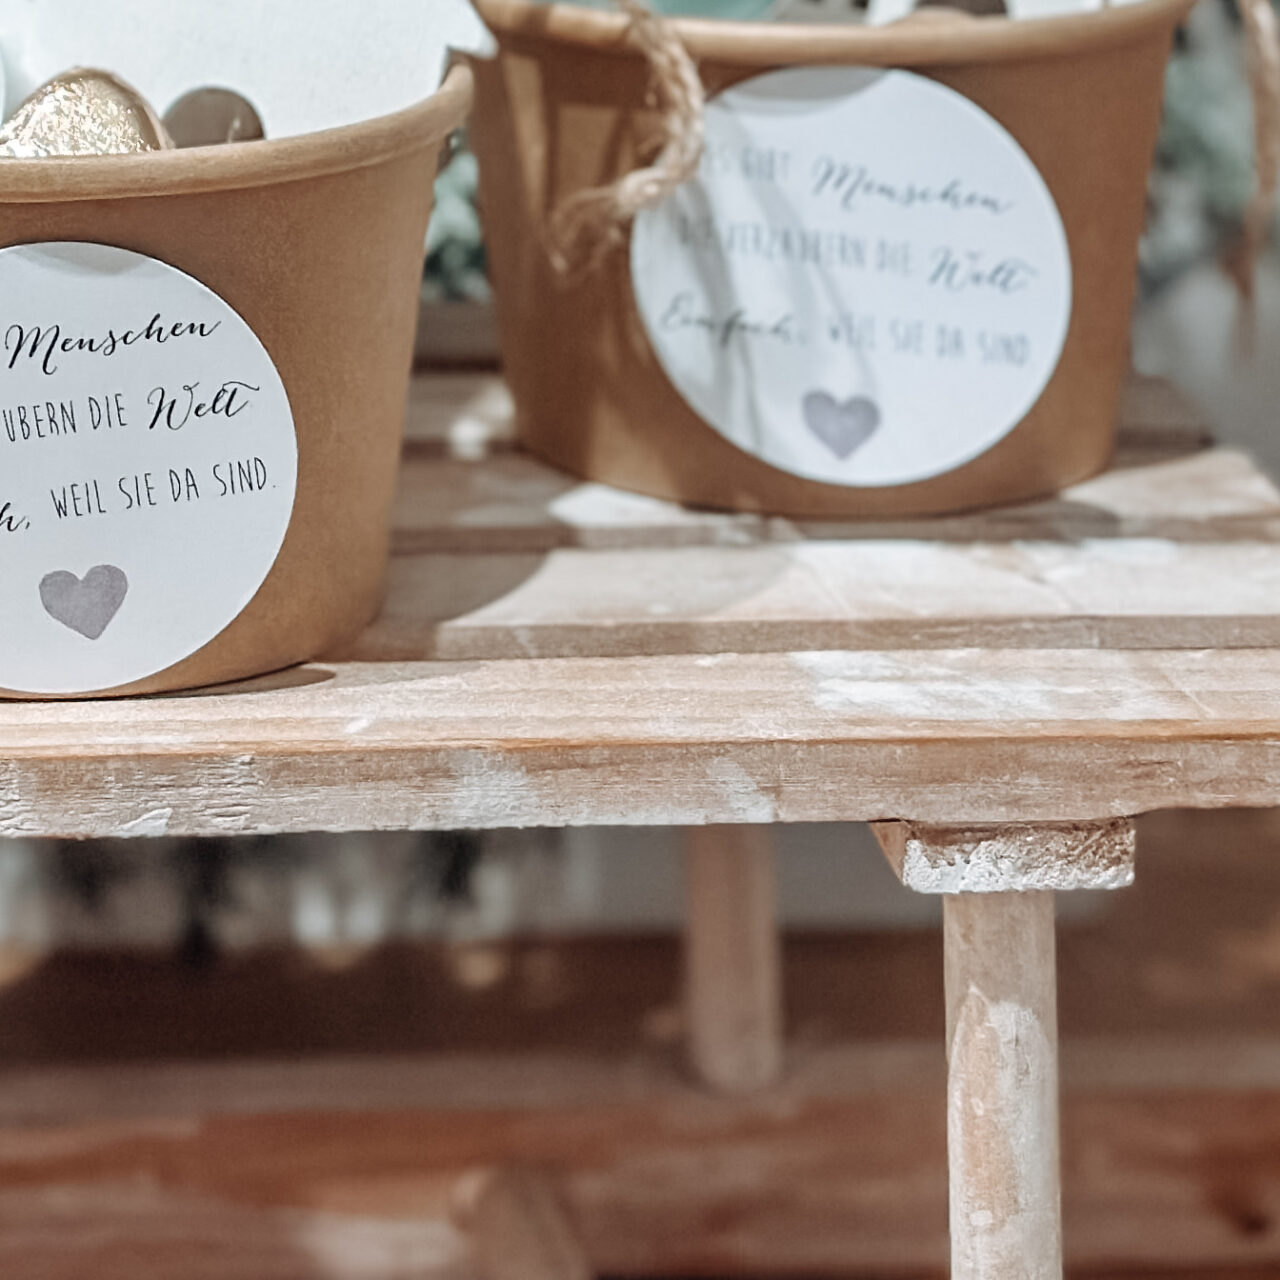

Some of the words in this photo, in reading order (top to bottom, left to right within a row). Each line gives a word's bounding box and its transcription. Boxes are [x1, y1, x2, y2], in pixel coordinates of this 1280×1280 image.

[812, 155, 1014, 213] Menschen
[928, 244, 1038, 293] Welt
[4, 312, 222, 375] Menschen
[88, 392, 128, 428] DIE
[146, 381, 260, 431] Welt
[50, 479, 107, 520] WEIL
[118, 472, 157, 510] SIE
[169, 467, 200, 504] DA
[212, 456, 279, 497] SIND.
